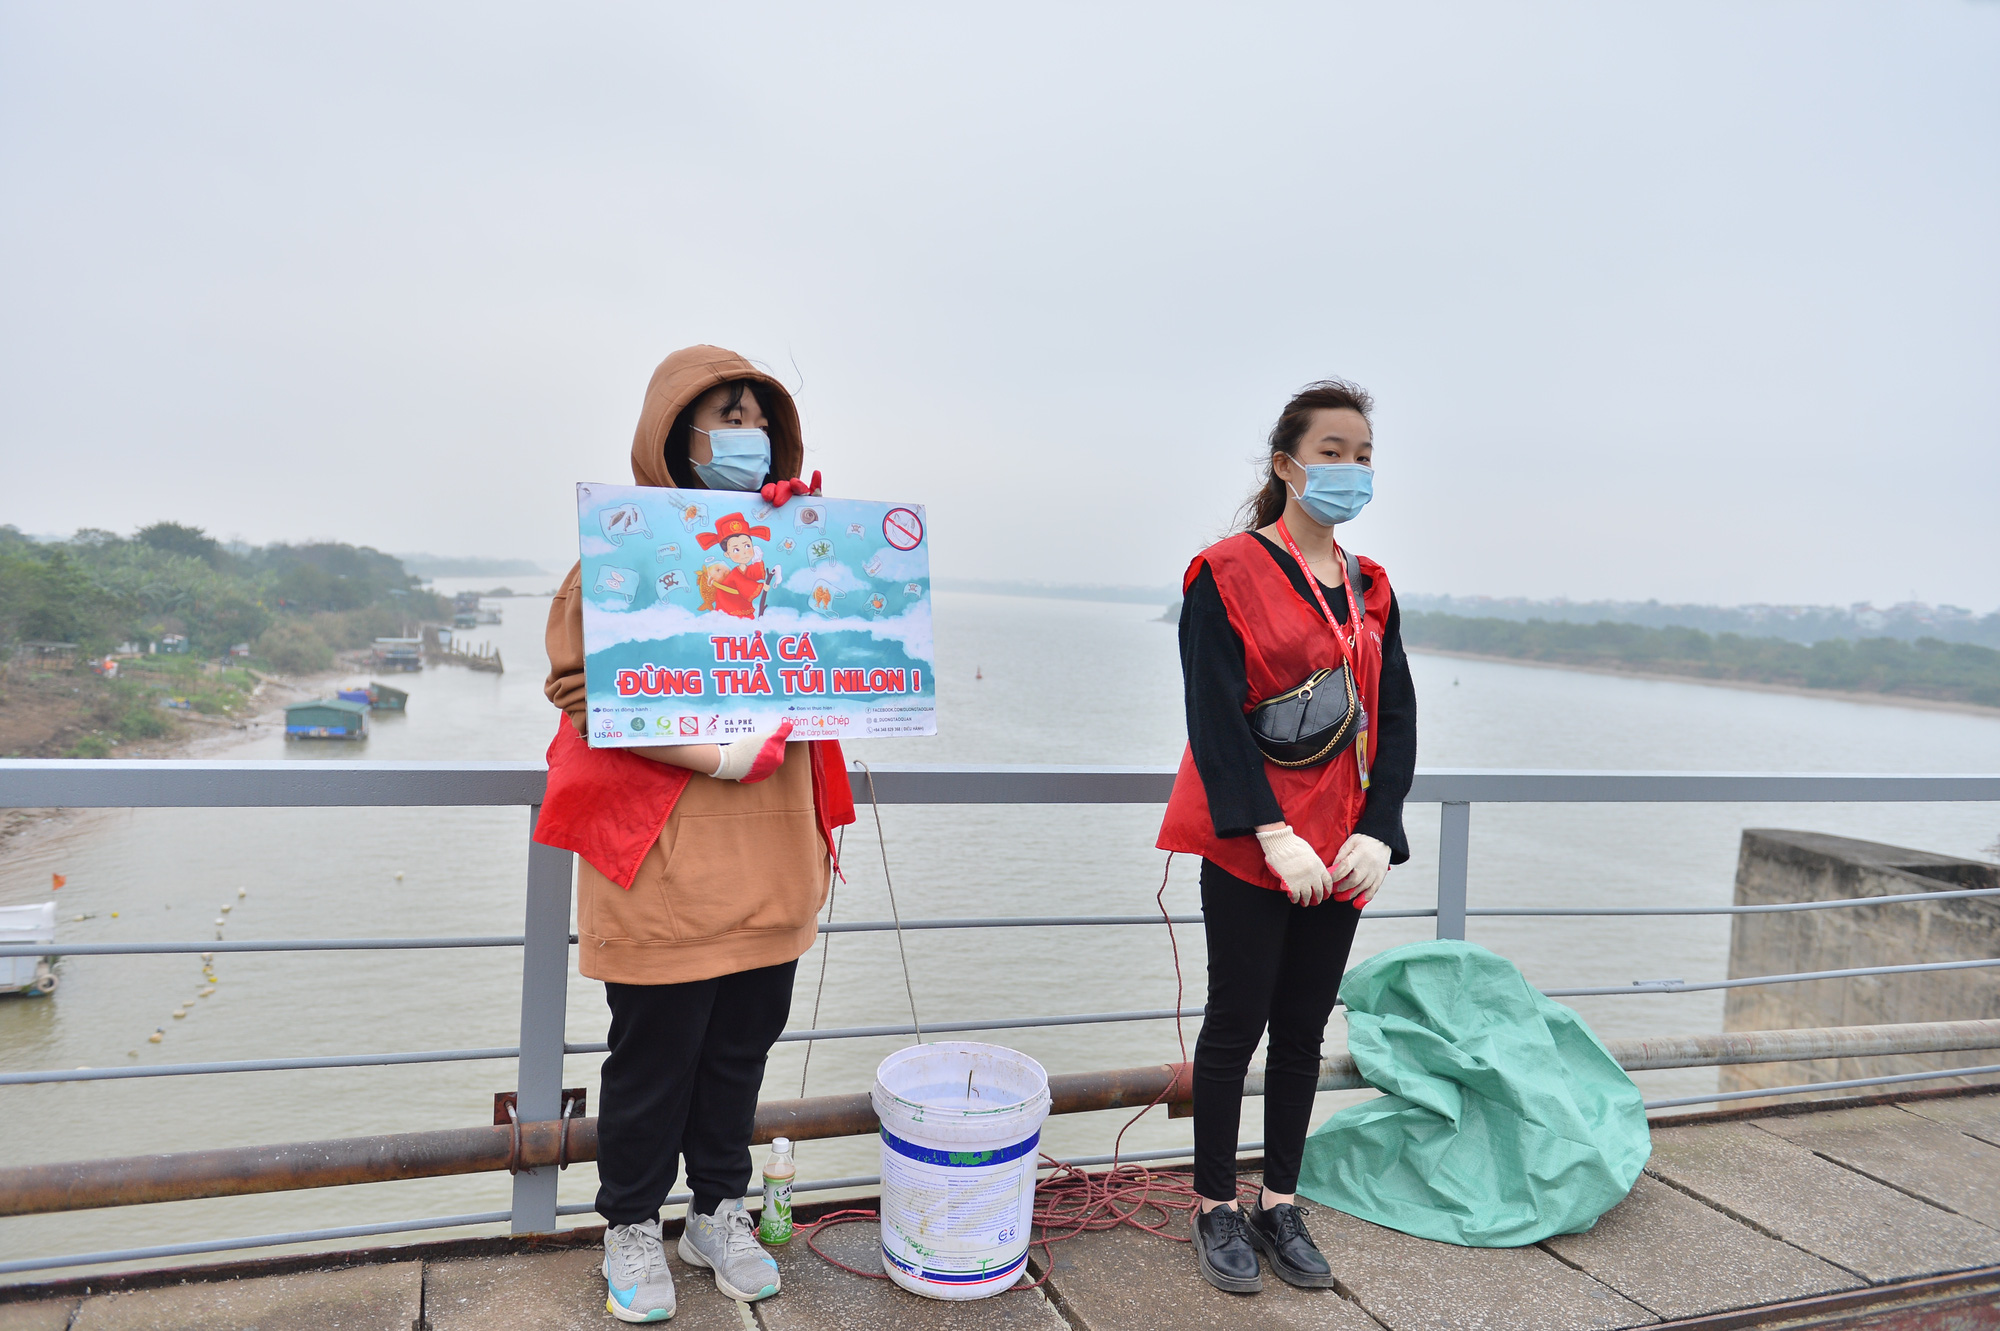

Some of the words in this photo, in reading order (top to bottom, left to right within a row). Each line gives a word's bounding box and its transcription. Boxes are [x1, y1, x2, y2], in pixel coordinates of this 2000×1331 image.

[1321, 601, 1331, 615] TEAM
[1329, 615, 1339, 630] CARP
[1336, 628, 1345, 640] THE
[711, 630, 770, 661] THẢ
[779, 632, 816, 661] CÁ
[617, 664, 702, 695] ĐỪNG
[712, 663, 771, 694] THẢ
[780, 664, 824, 693] TÚI
[832, 669, 904, 693] NILON
[826, 714, 850, 727] Chép
[793, 730, 806, 738] (the
[807, 729, 821, 737] Carp
[821, 729, 840, 737] team)
